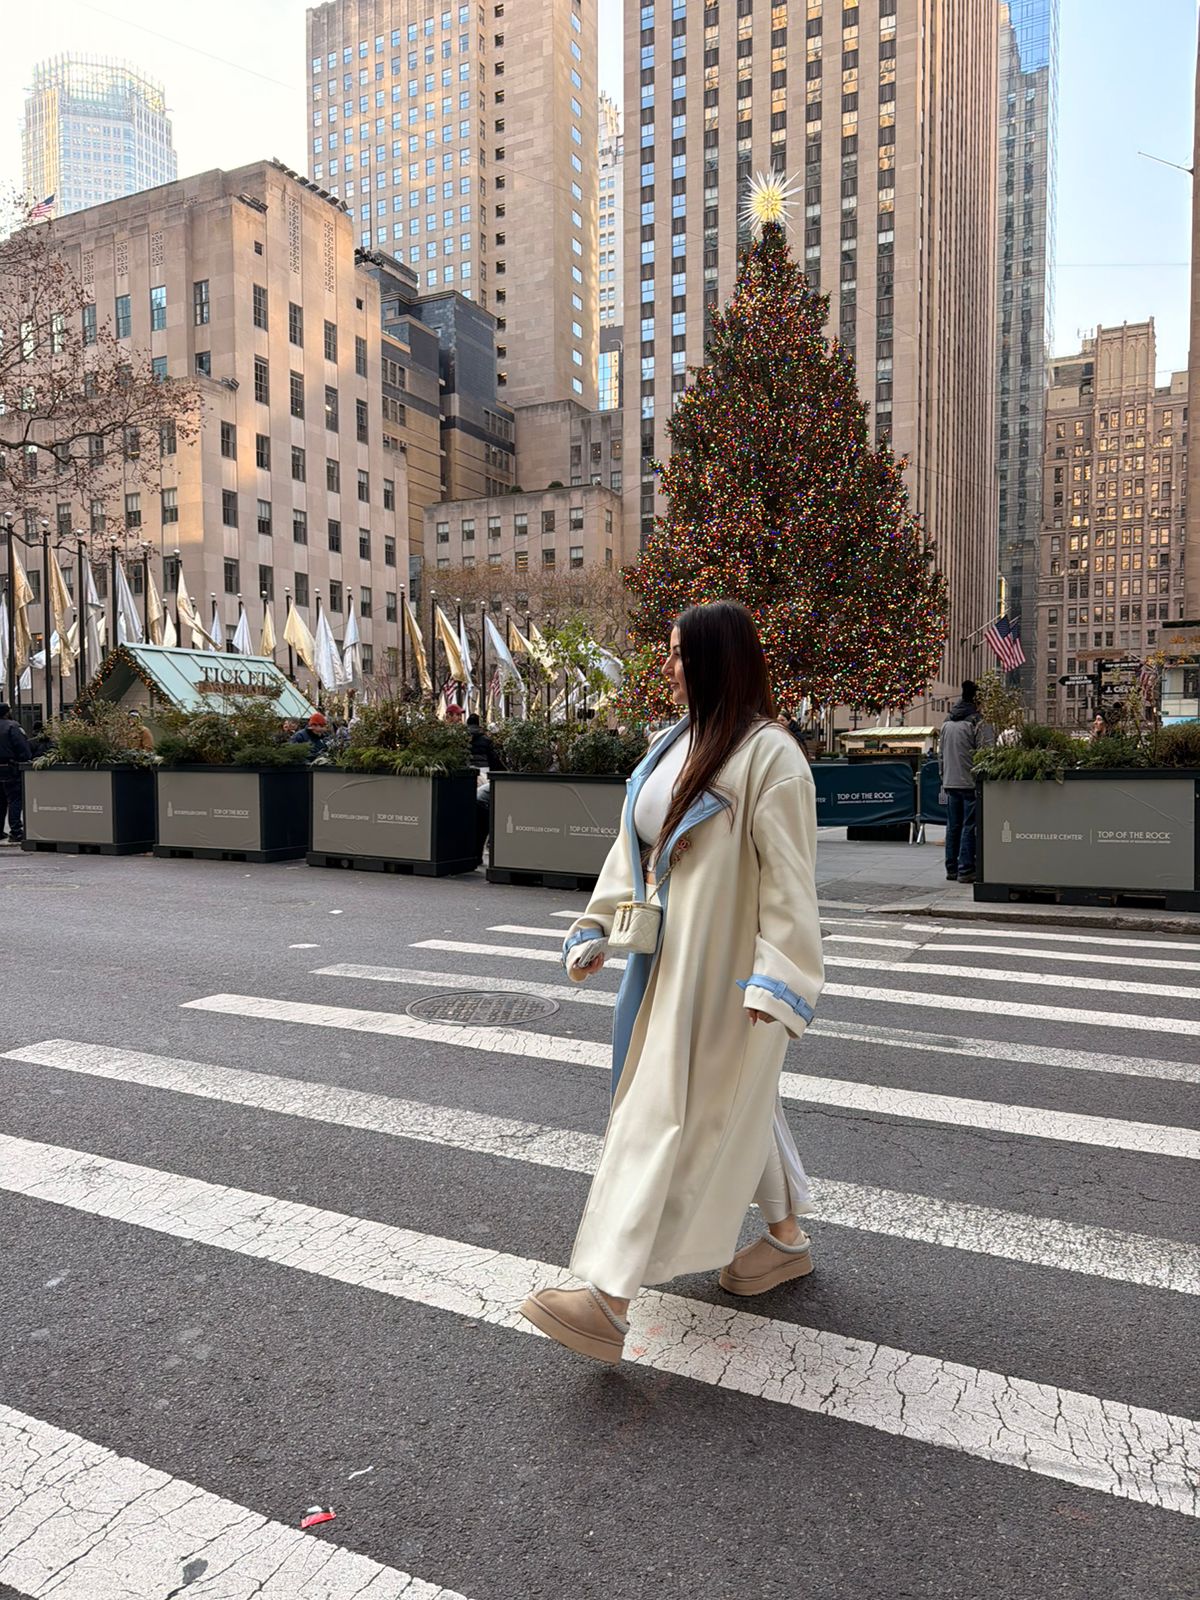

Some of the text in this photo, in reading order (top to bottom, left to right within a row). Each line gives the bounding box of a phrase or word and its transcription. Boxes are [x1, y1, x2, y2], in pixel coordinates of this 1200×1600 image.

[851, 792, 860, 800] OF
[581, 825, 589, 833] OF
[600, 827, 617, 835] ROCK
[1097, 831, 1113, 839] TOP
[1115, 831, 1127, 839] OF
[1145, 832, 1170, 840] ROCK
